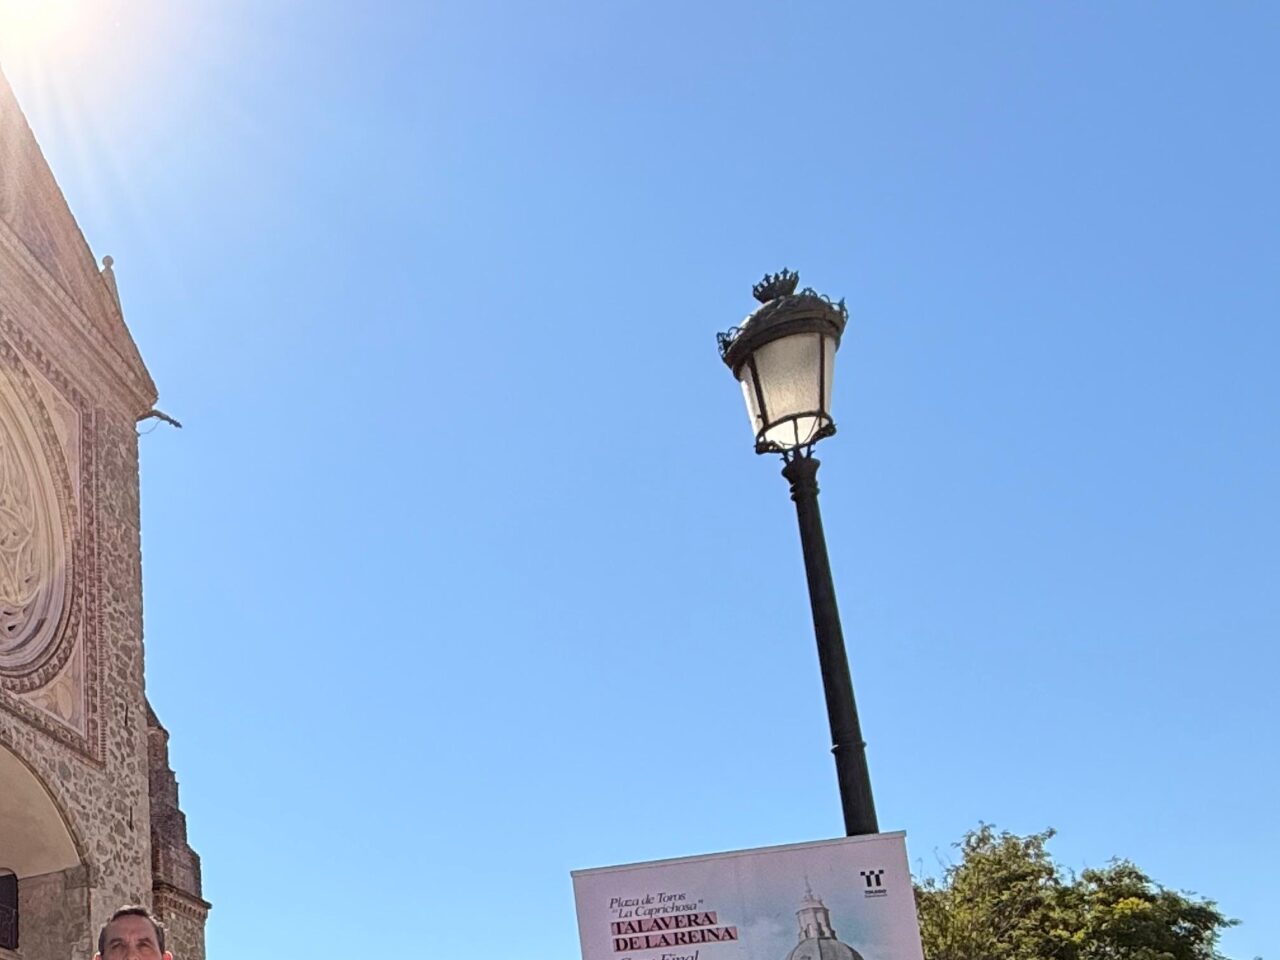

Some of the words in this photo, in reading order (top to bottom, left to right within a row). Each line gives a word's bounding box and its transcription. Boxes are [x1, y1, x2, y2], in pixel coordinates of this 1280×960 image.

[610, 896, 639, 909] Plaza
[641, 894, 654, 906] de
[657, 892, 686, 903] Toros
[613, 912, 716, 935] TALAVERA
[615, 937, 641, 951] DE
[645, 933, 671, 948] LA
[673, 927, 736, 946] REINA
